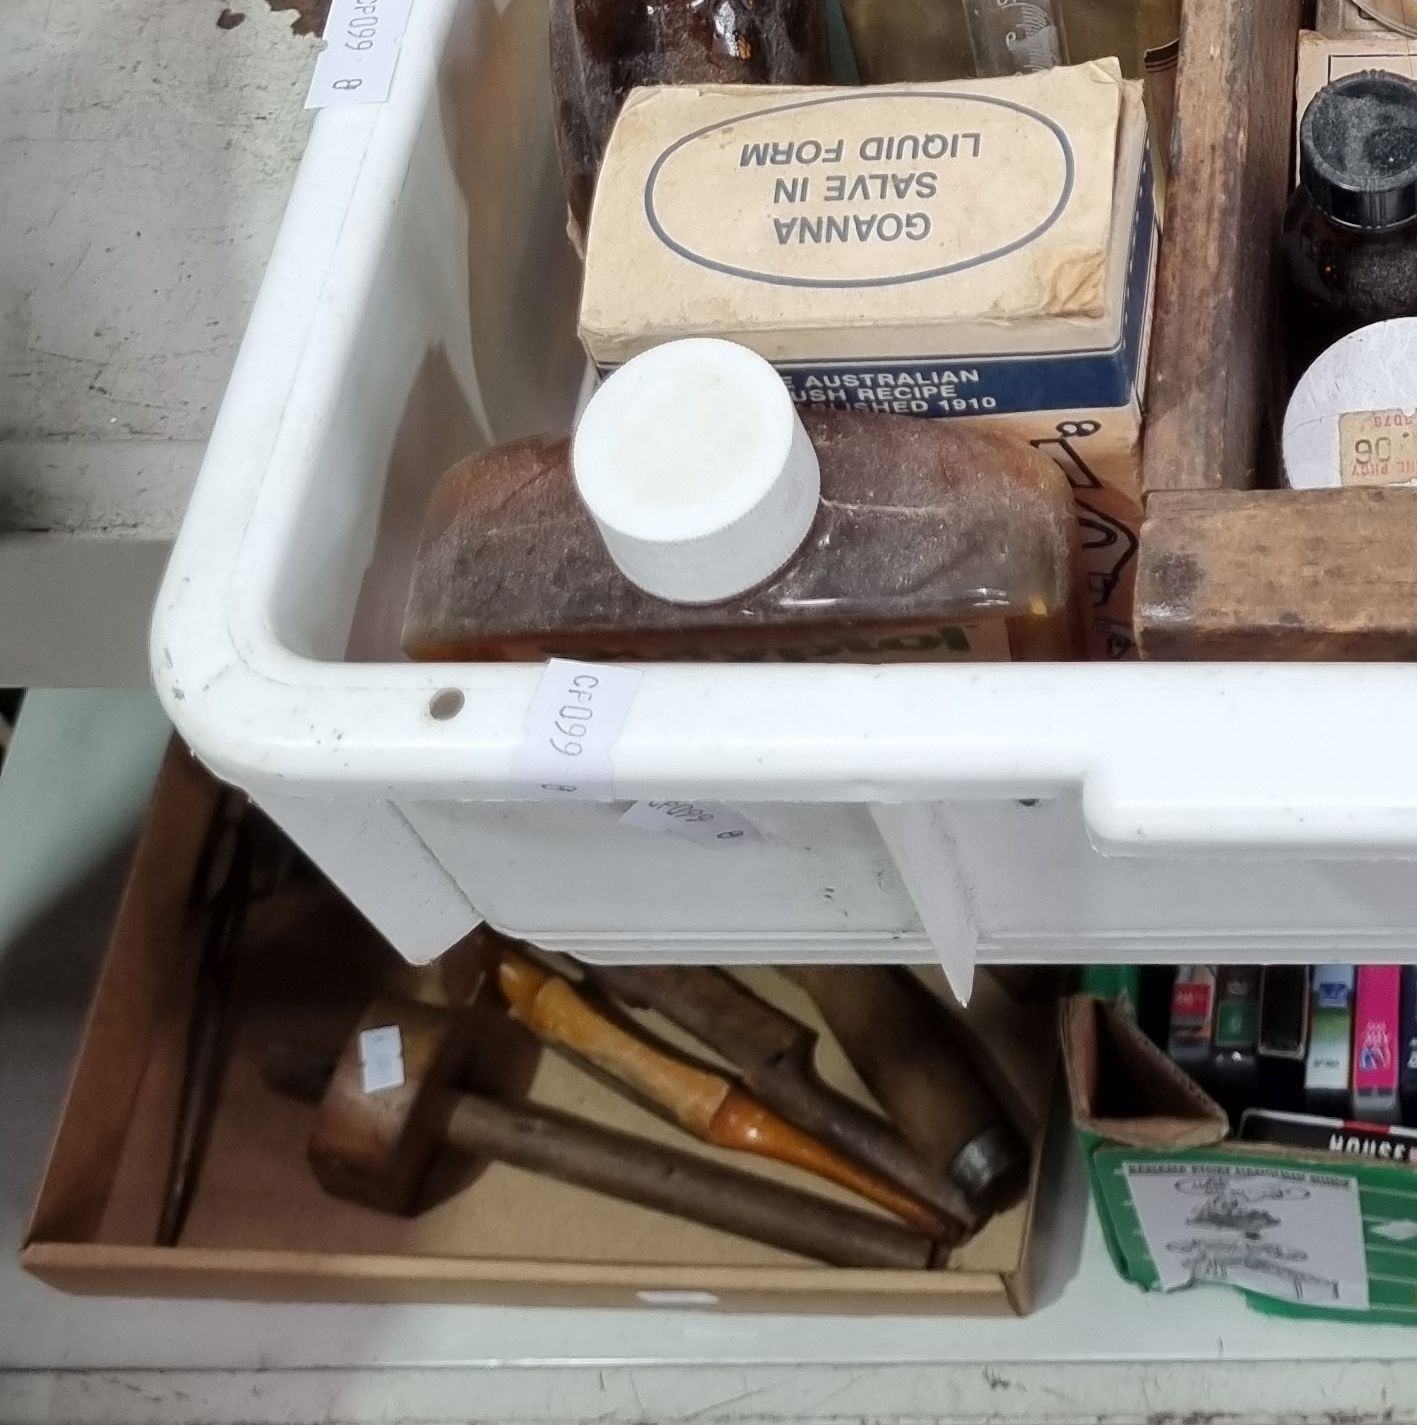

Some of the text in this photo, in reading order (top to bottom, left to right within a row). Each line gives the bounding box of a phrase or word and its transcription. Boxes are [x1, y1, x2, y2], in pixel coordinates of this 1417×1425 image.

[740, 132, 981, 167] LIQUID FORM
[775, 172, 938, 204] SALVE IN
[774, 212, 932, 245] GOANNA
[805, 369, 980, 388] AUSTRALIAN
[857, 384, 958, 402] RECIPE
[938, 396, 997, 412] 1910
